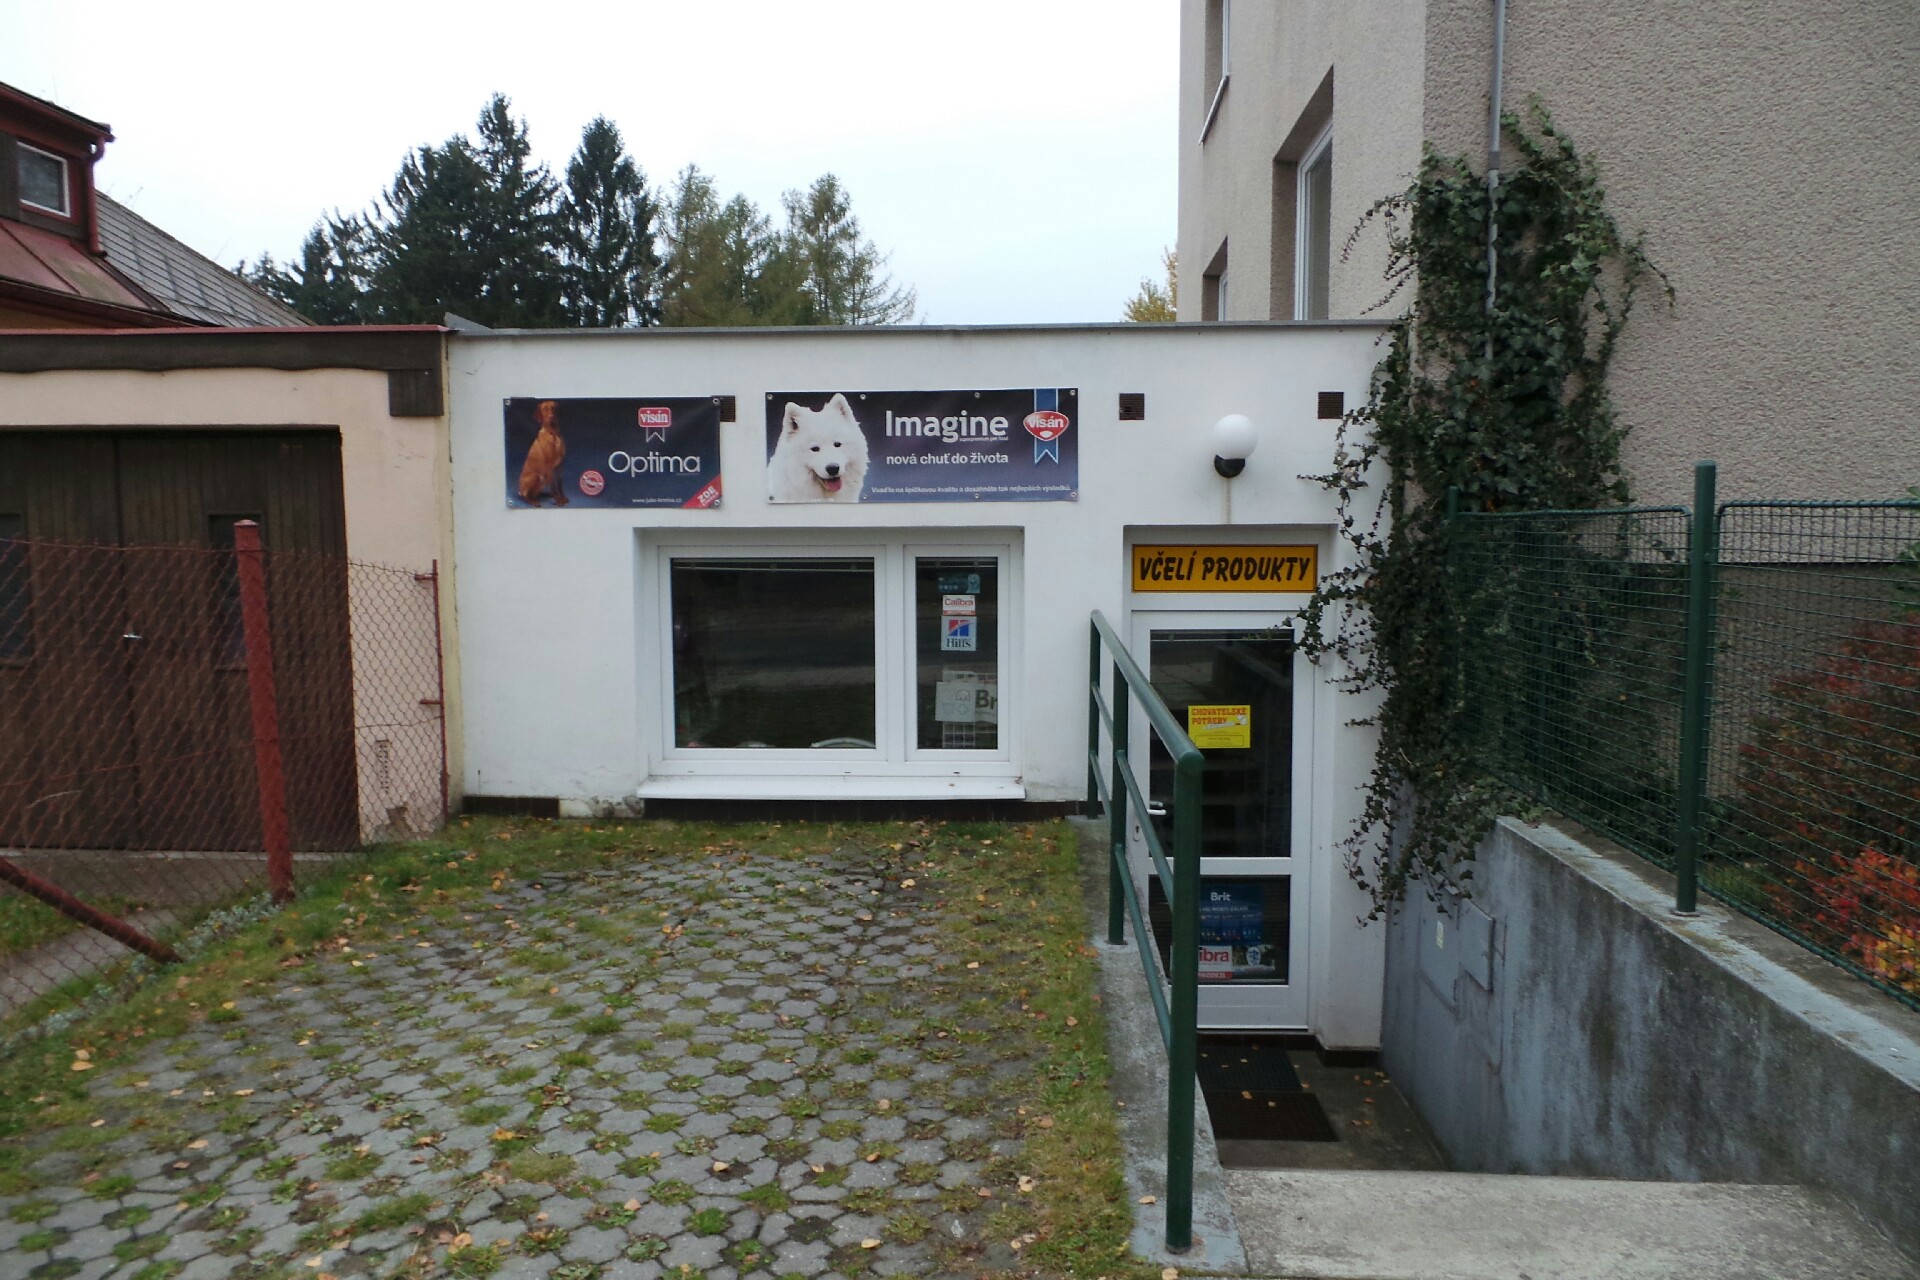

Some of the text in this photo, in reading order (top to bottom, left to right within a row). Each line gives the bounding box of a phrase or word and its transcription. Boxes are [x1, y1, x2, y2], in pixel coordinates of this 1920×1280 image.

[885, 409, 1009, 443] Imagine
[608, 450, 701, 478] Optima
[886, 451, 1009, 465] nová chuť do života
[697, 485, 716, 503] ZDE
[1140, 550, 1311, 582] VČELÍ PRODUKTY
[1210, 892, 1231, 901] Brit
